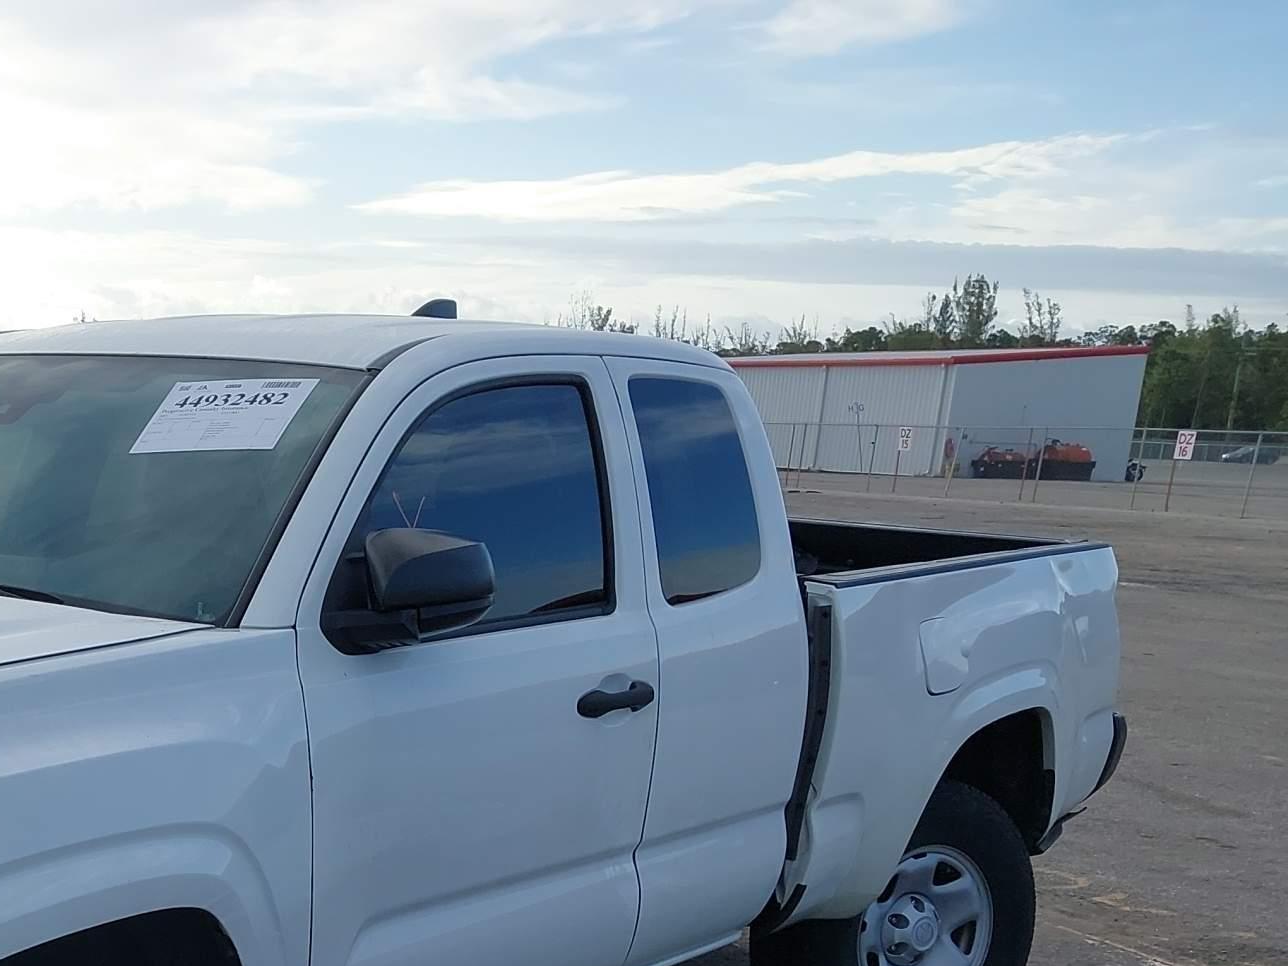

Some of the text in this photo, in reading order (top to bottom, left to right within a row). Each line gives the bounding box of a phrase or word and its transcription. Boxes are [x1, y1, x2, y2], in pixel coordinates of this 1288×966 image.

[175, 393, 289, 408] 44932482
[901, 428, 912, 438] DZ
[902, 439, 909, 448] 15
[1179, 433, 1195, 445] DZ
[1178, 446, 1188, 457] 16
